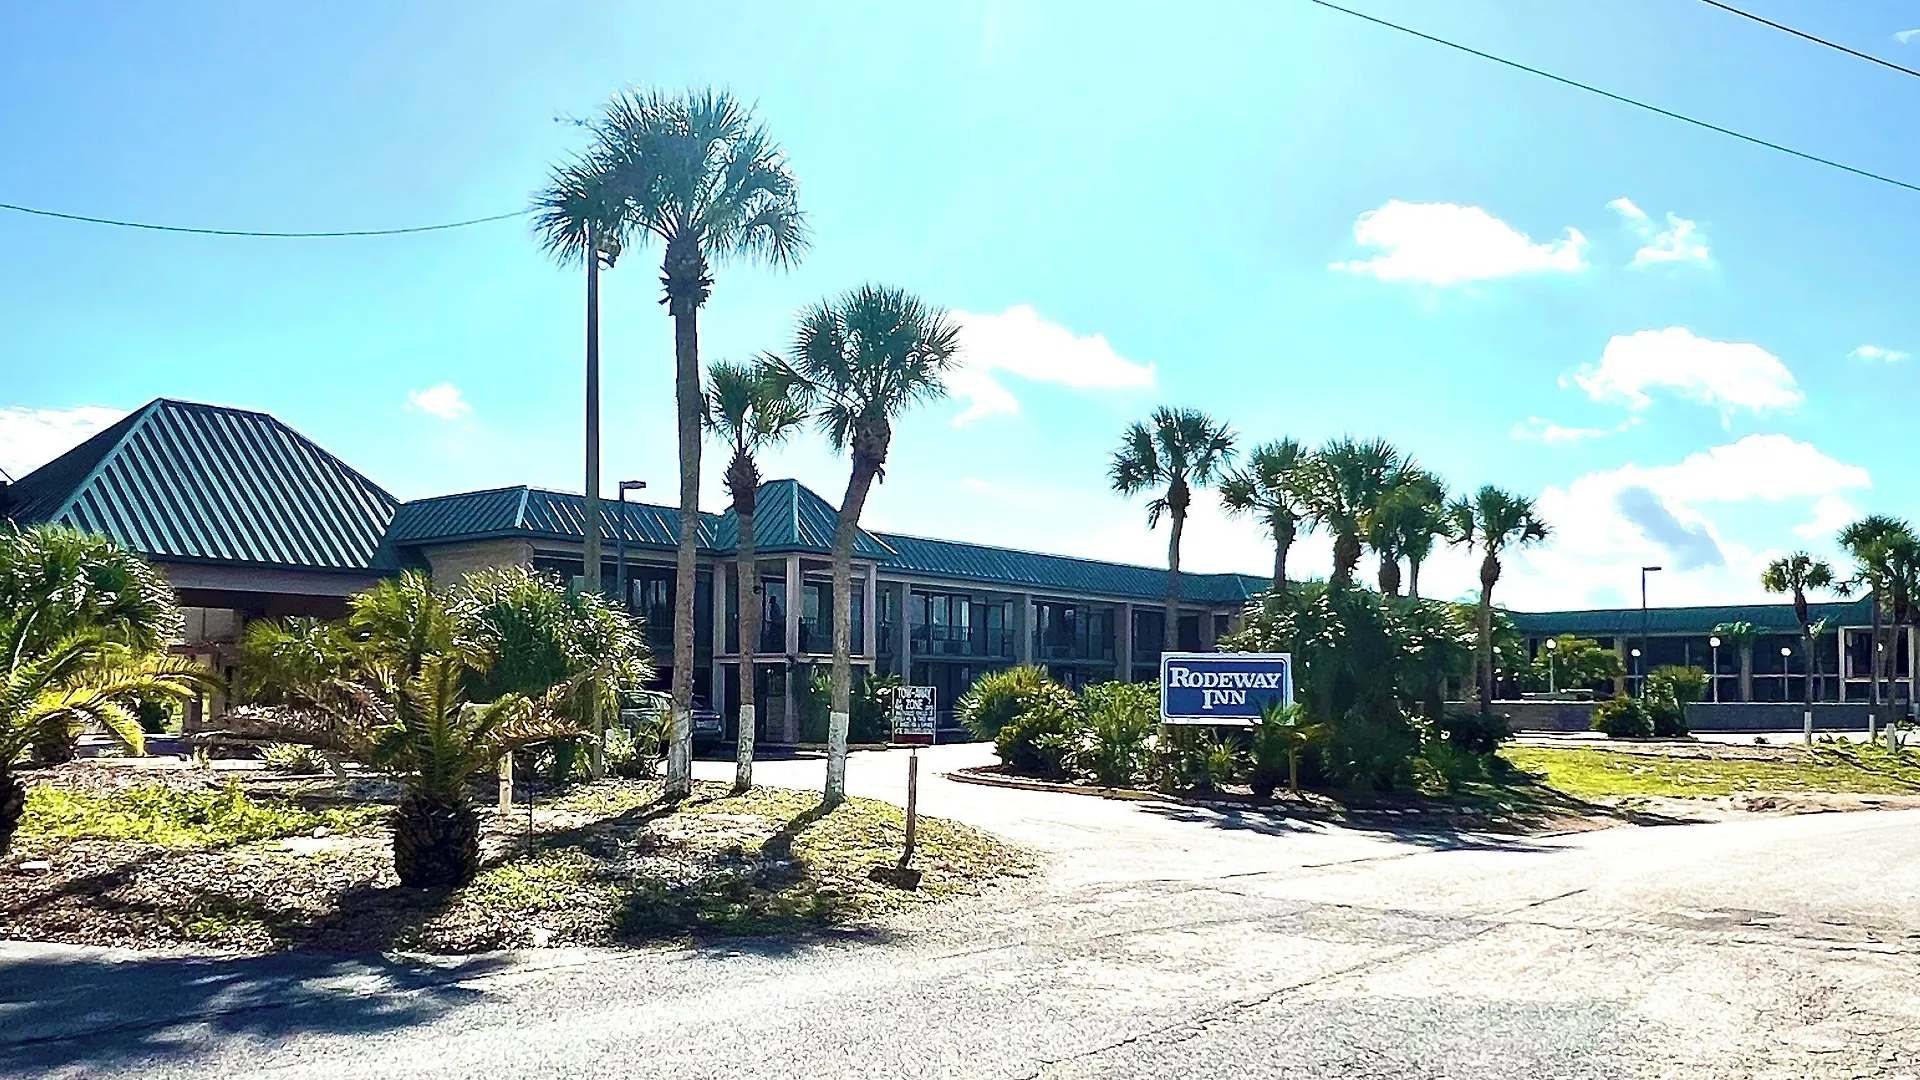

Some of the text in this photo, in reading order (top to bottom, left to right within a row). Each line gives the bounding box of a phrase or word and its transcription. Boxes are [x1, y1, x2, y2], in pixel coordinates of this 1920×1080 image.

[1169, 667, 1281, 689] RODEWAY
[905, 698, 924, 710] ZONE
[1202, 689, 1247, 710] INN
